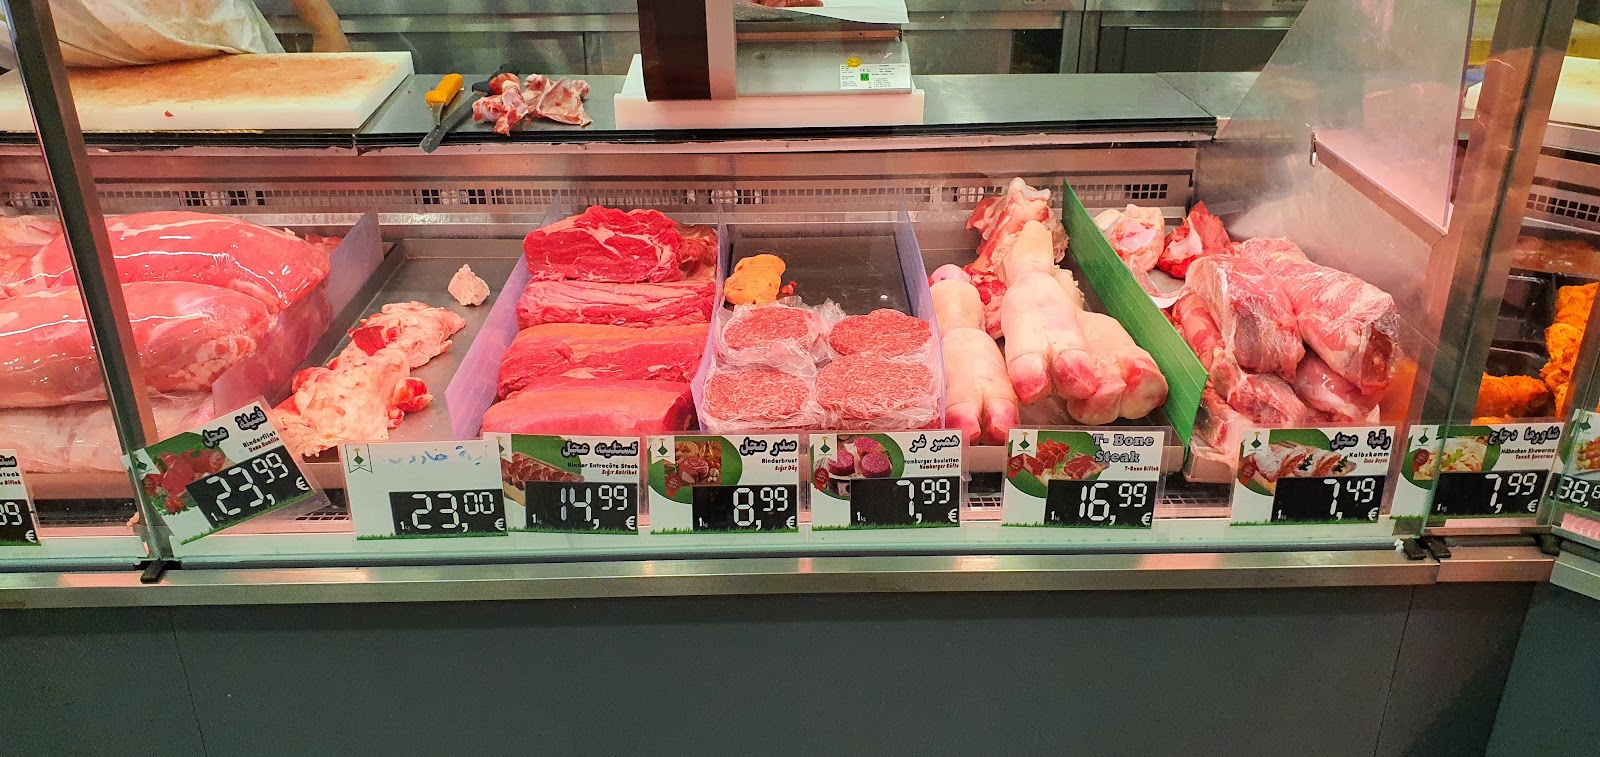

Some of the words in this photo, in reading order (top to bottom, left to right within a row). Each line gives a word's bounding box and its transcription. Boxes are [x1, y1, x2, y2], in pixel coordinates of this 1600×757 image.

[202, 427, 230, 448] عجل
[739, 436, 767, 456] عجل
[909, 434, 927, 453] غر
[930, 435, 960, 452] همبر
[1113, 434, 1155, 446] Bone
[1329, 431, 1359, 452] عجل
[1367, 429, 1392, 450] رقبة
[1488, 427, 1518, 445] دجاج
[1524, 426, 1561, 445] شاورما
[561, 439, 590, 458] عجل
[770, 438, 797, 456] صدر
[1095, 450, 1140, 463] Steak
[206, 453, 289, 516] 23,99
[296, 477, 310, 491] €
[1485, 472, 1537, 513] 7,99
[1527, 499, 1539, 512] €
[560, 484, 627, 530] 14,99
[625, 516, 636, 530] €
[732, 486, 788, 530] 8,99
[785, 515, 796, 529] €
[896, 478, 950, 524] 7,99
[947, 508, 958, 523] €
[1079, 482, 1148, 526] 16,99
[1141, 511, 1152, 526] €
[1323, 477, 1376, 520] 7,49
[1367, 507, 1379, 521] €
[411, 492, 495, 532] 23,00
[494, 518, 505, 530] €
